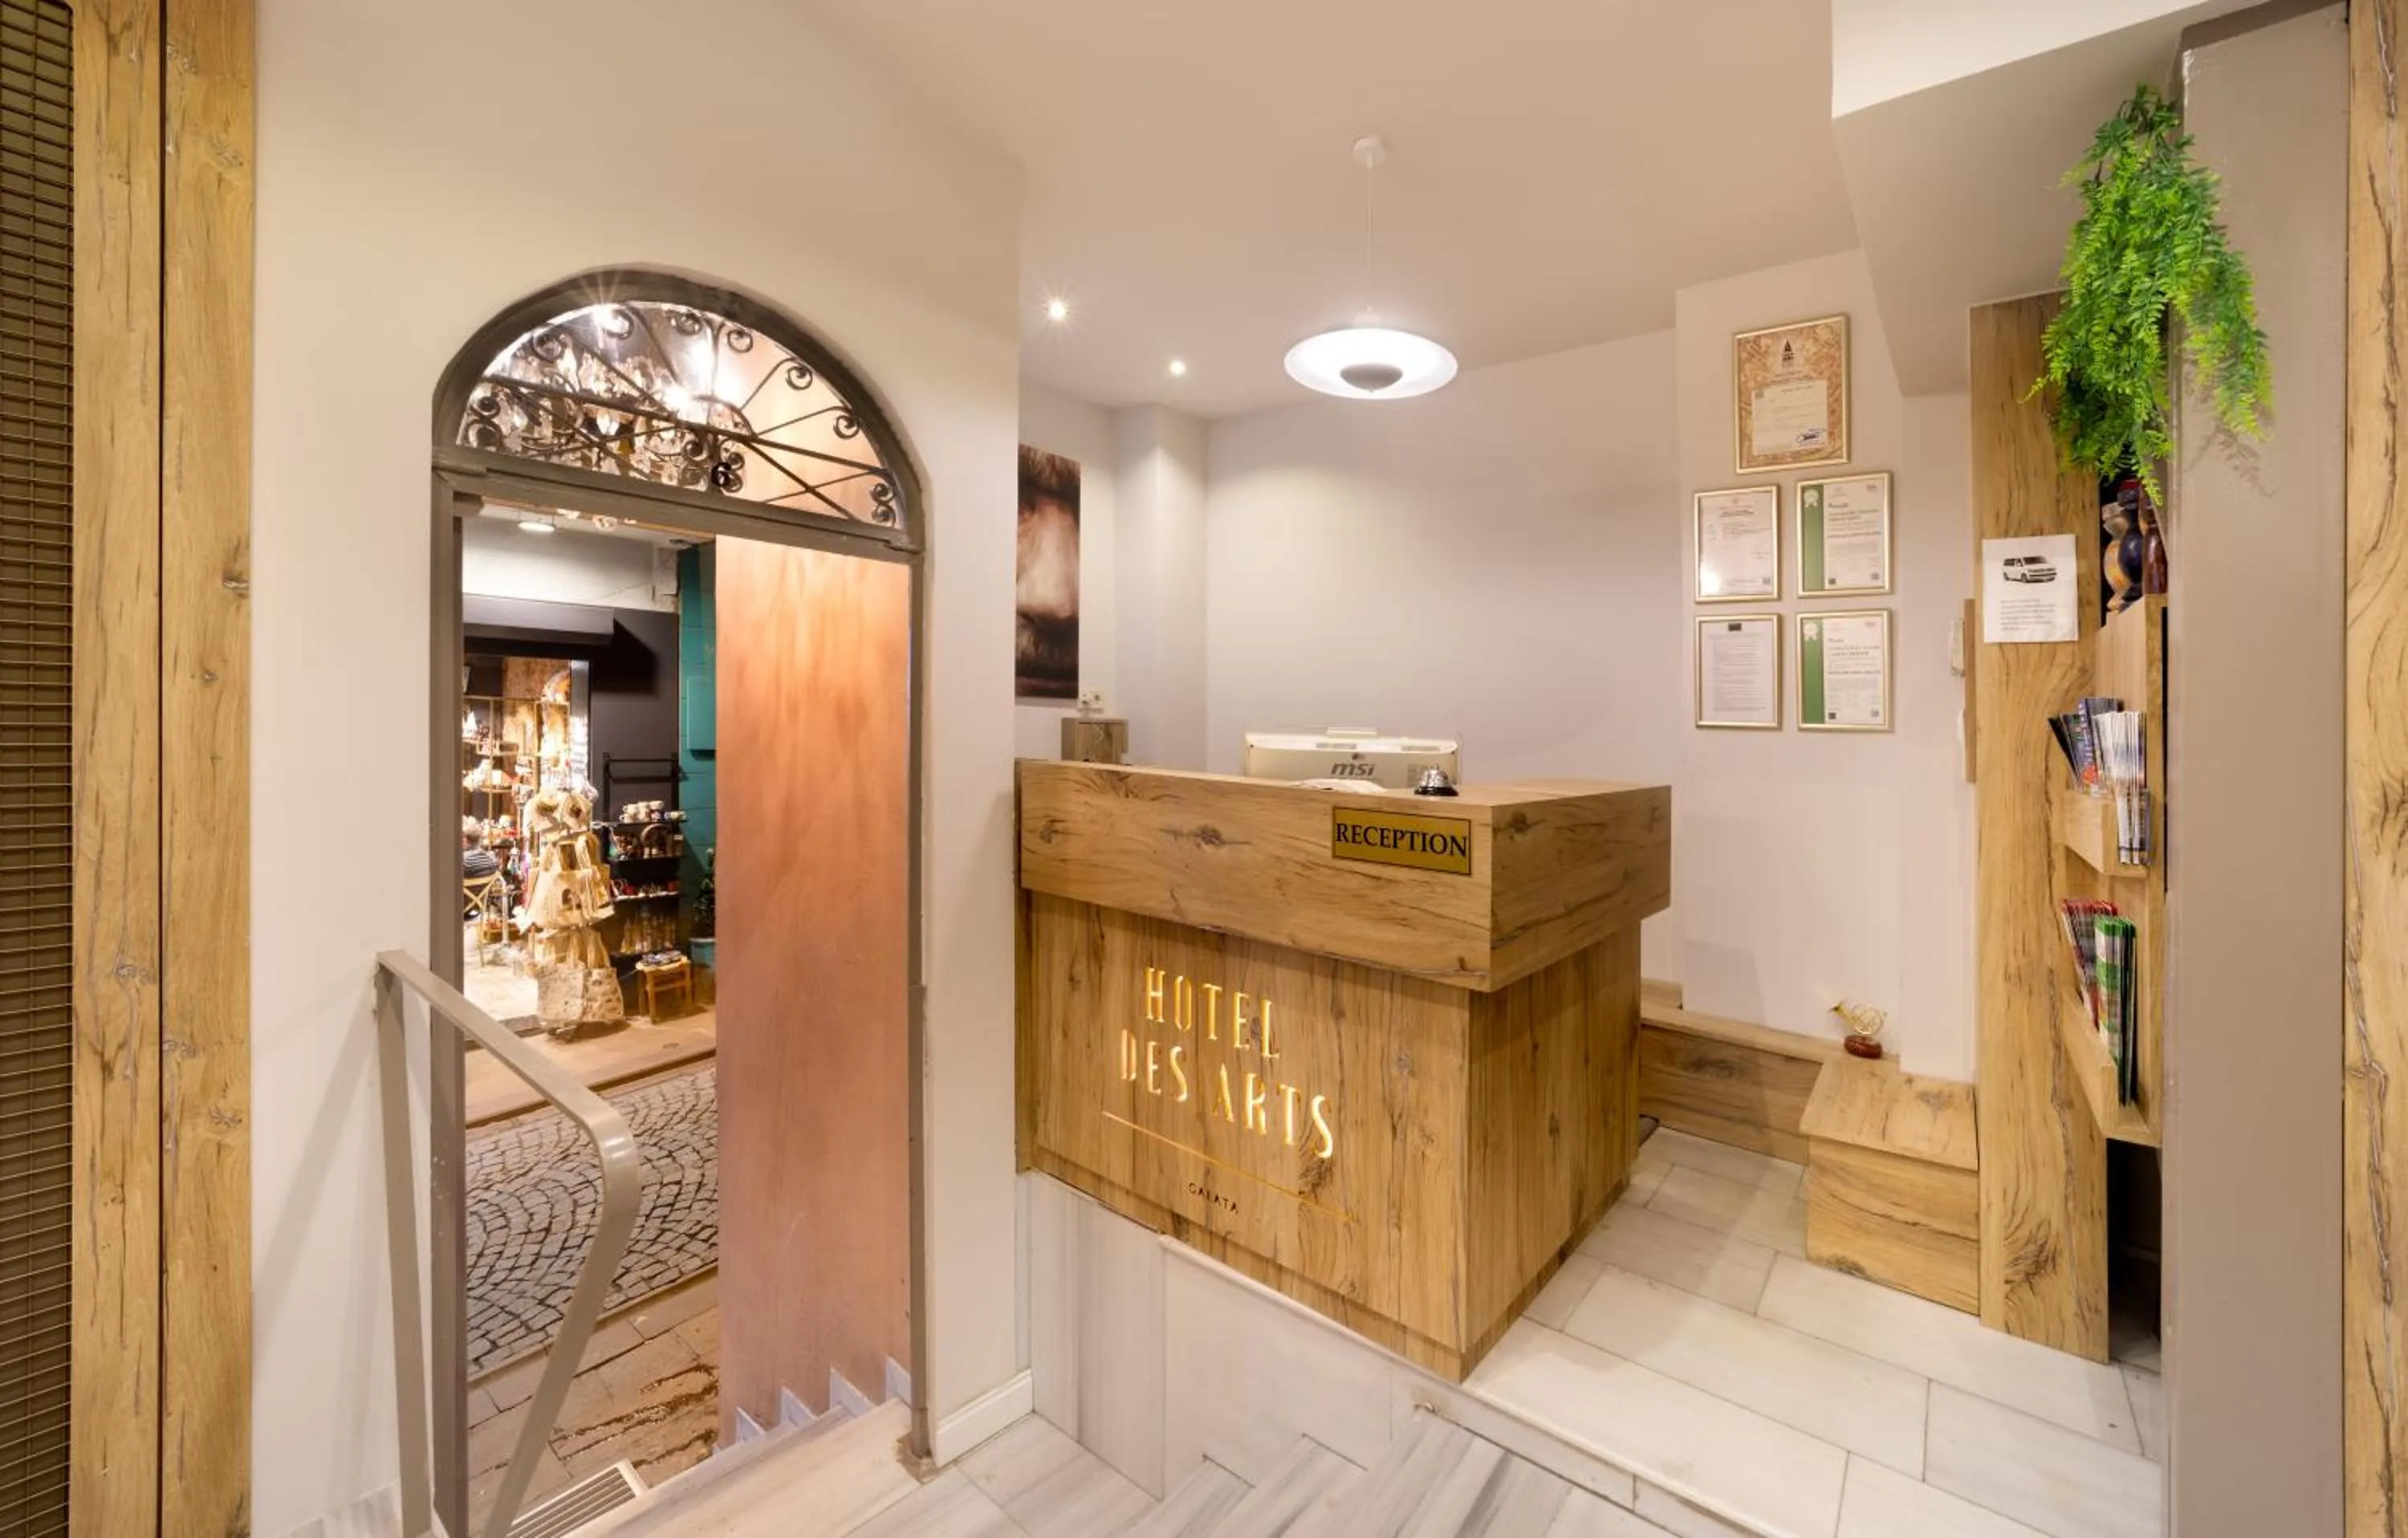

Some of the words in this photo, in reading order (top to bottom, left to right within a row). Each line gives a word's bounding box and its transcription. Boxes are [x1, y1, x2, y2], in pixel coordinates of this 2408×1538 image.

[1330, 762, 1376, 777] msi
[1335, 822, 1468, 857] RECEPTION
[1144, 966, 1280, 1060] HOTEL
[1121, 1028, 1189, 1104] DES
[1211, 1062, 1334, 1158] ARTS
[1187, 1182, 1240, 1215] GALATA
